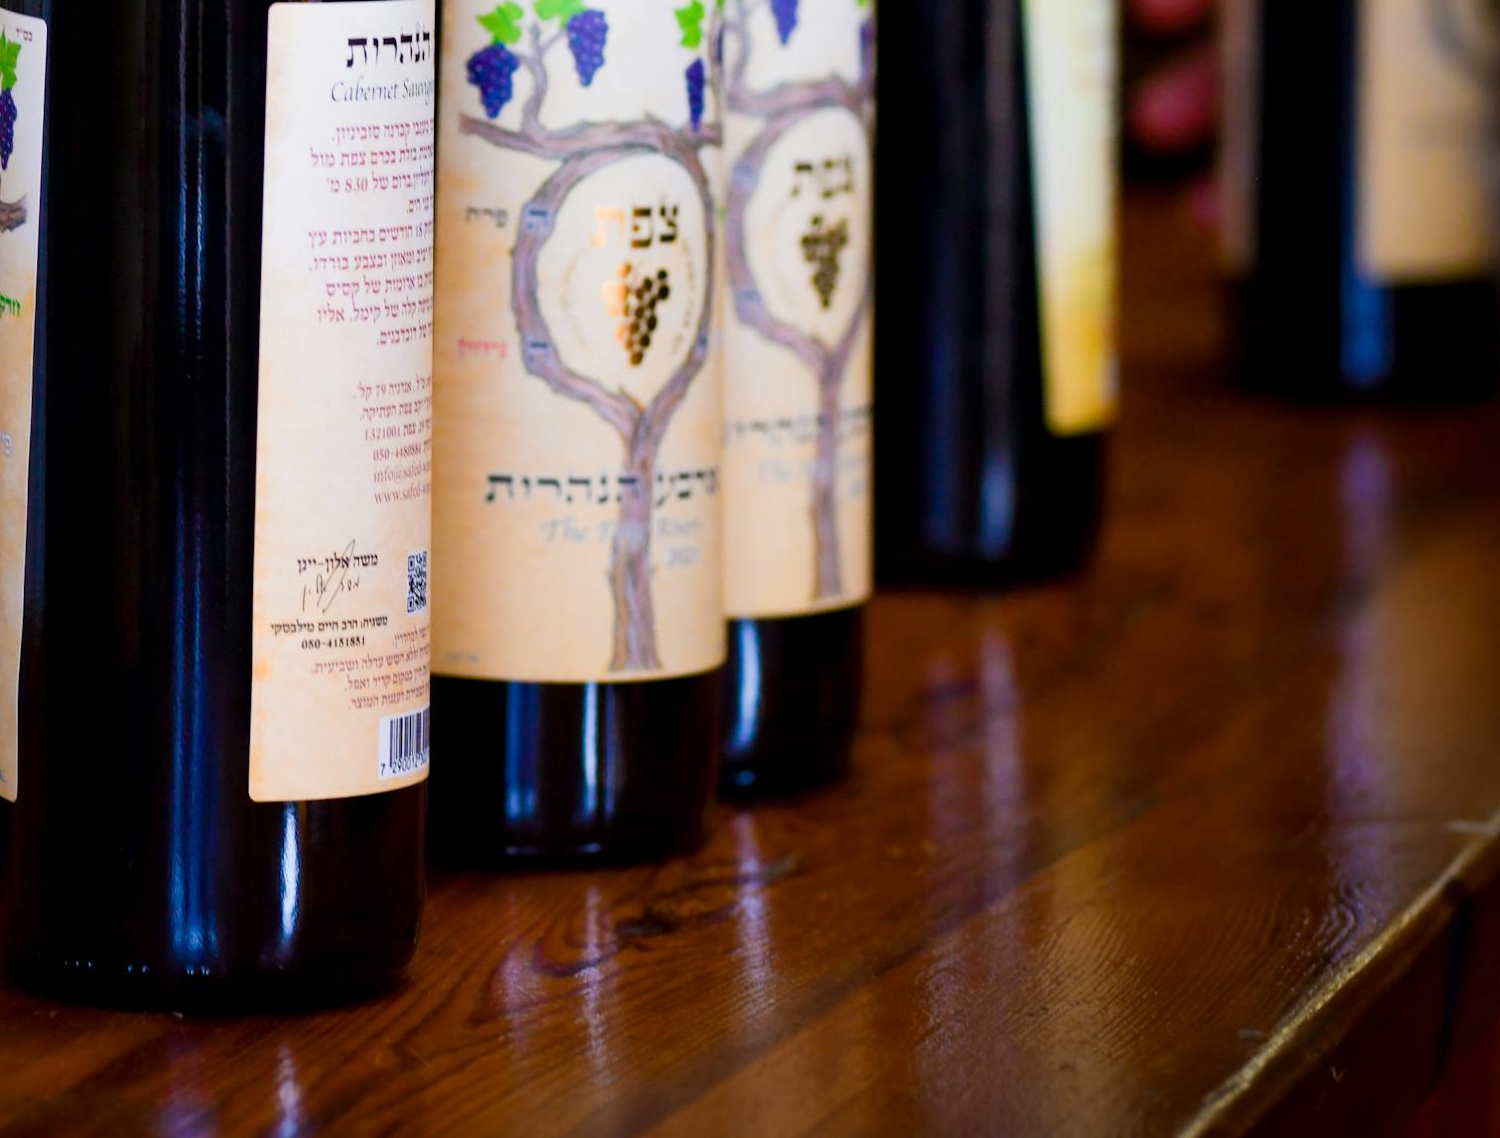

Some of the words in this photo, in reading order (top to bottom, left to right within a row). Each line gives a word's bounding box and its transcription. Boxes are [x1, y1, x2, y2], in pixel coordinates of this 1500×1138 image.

[331, 77, 399, 103] Cabernet
[384, 123, 411, 146] קברנה
[310, 146, 335, 167] מול
[341, 150, 366, 167] צפת
[345, 176, 368, 193] 830
[372, 170, 389, 191] של
[589, 195, 680, 250] צפת
[308, 230, 328, 249] עץ
[308, 257, 349, 271] בורדו.
[363, 275, 381, 294] של
[384, 298, 400, 318] של
[353, 553, 379, 568] משה
